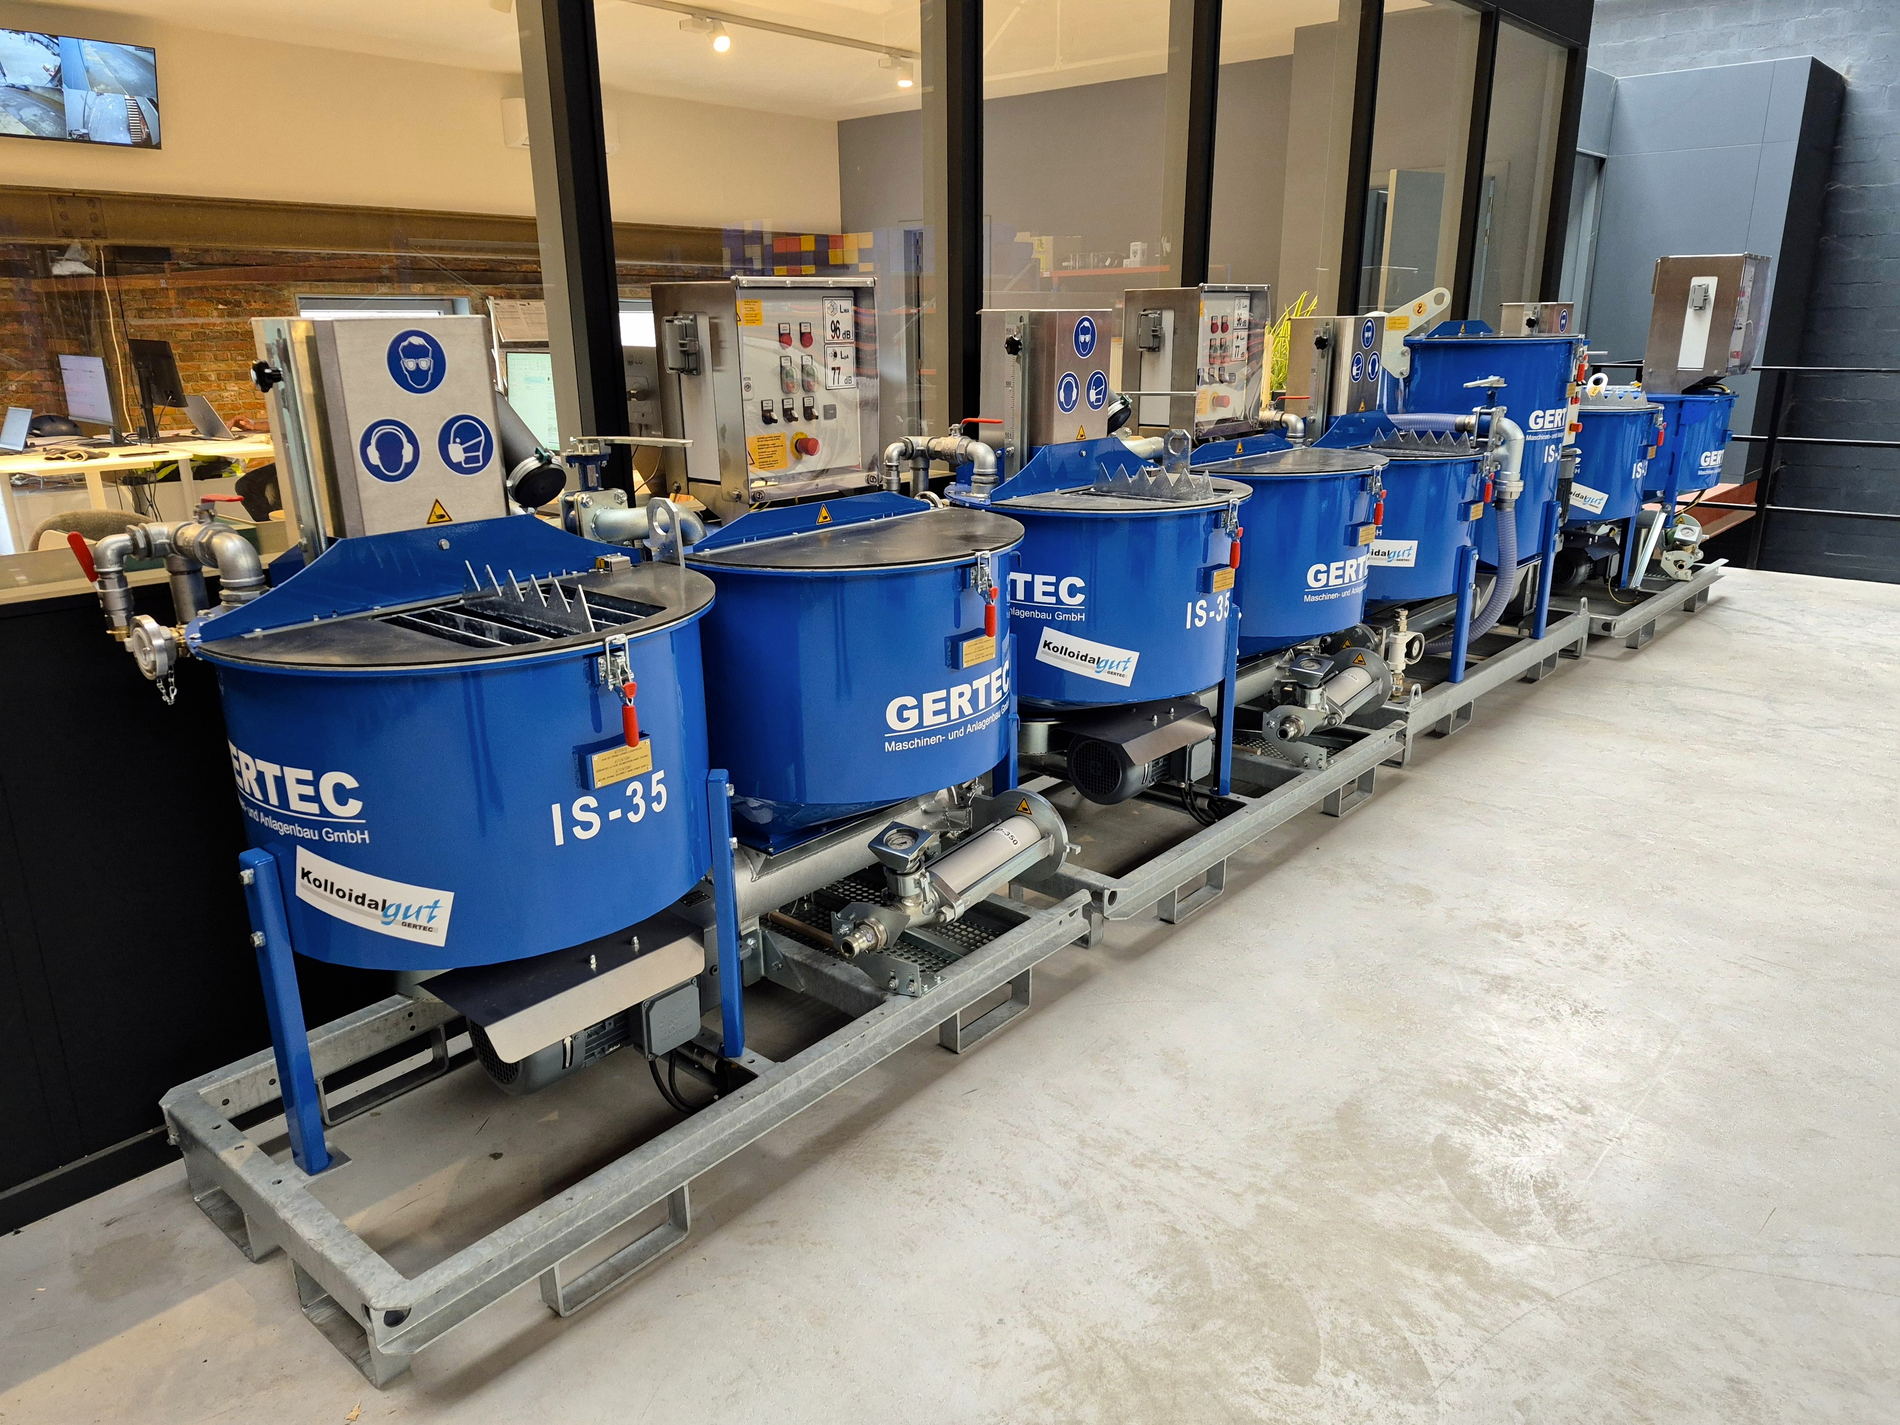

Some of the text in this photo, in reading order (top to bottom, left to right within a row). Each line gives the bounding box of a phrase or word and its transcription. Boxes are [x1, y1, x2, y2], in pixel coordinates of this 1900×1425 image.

[830, 320, 851, 340] 96 dB
[831, 366, 841, 386] 77
[1529, 408, 1567, 430] GERT
[1009, 571, 1086, 606] TEC
[1054, 611, 1086, 622] GmbH
[1186, 591, 1231, 630] IS-35
[885, 659, 1010, 731] GERTEC
[884, 735, 946, 752] Maschinen-
[948, 726, 965, 740] und
[966, 711, 1001, 735] Anlagenbau
[227, 739, 364, 818] ERTEC
[551, 769, 667, 847] IS-35
[260, 811, 320, 840] Anlagenbau
[321, 827, 370, 844] GmbH
[401, 921, 434, 933] GERTEC
